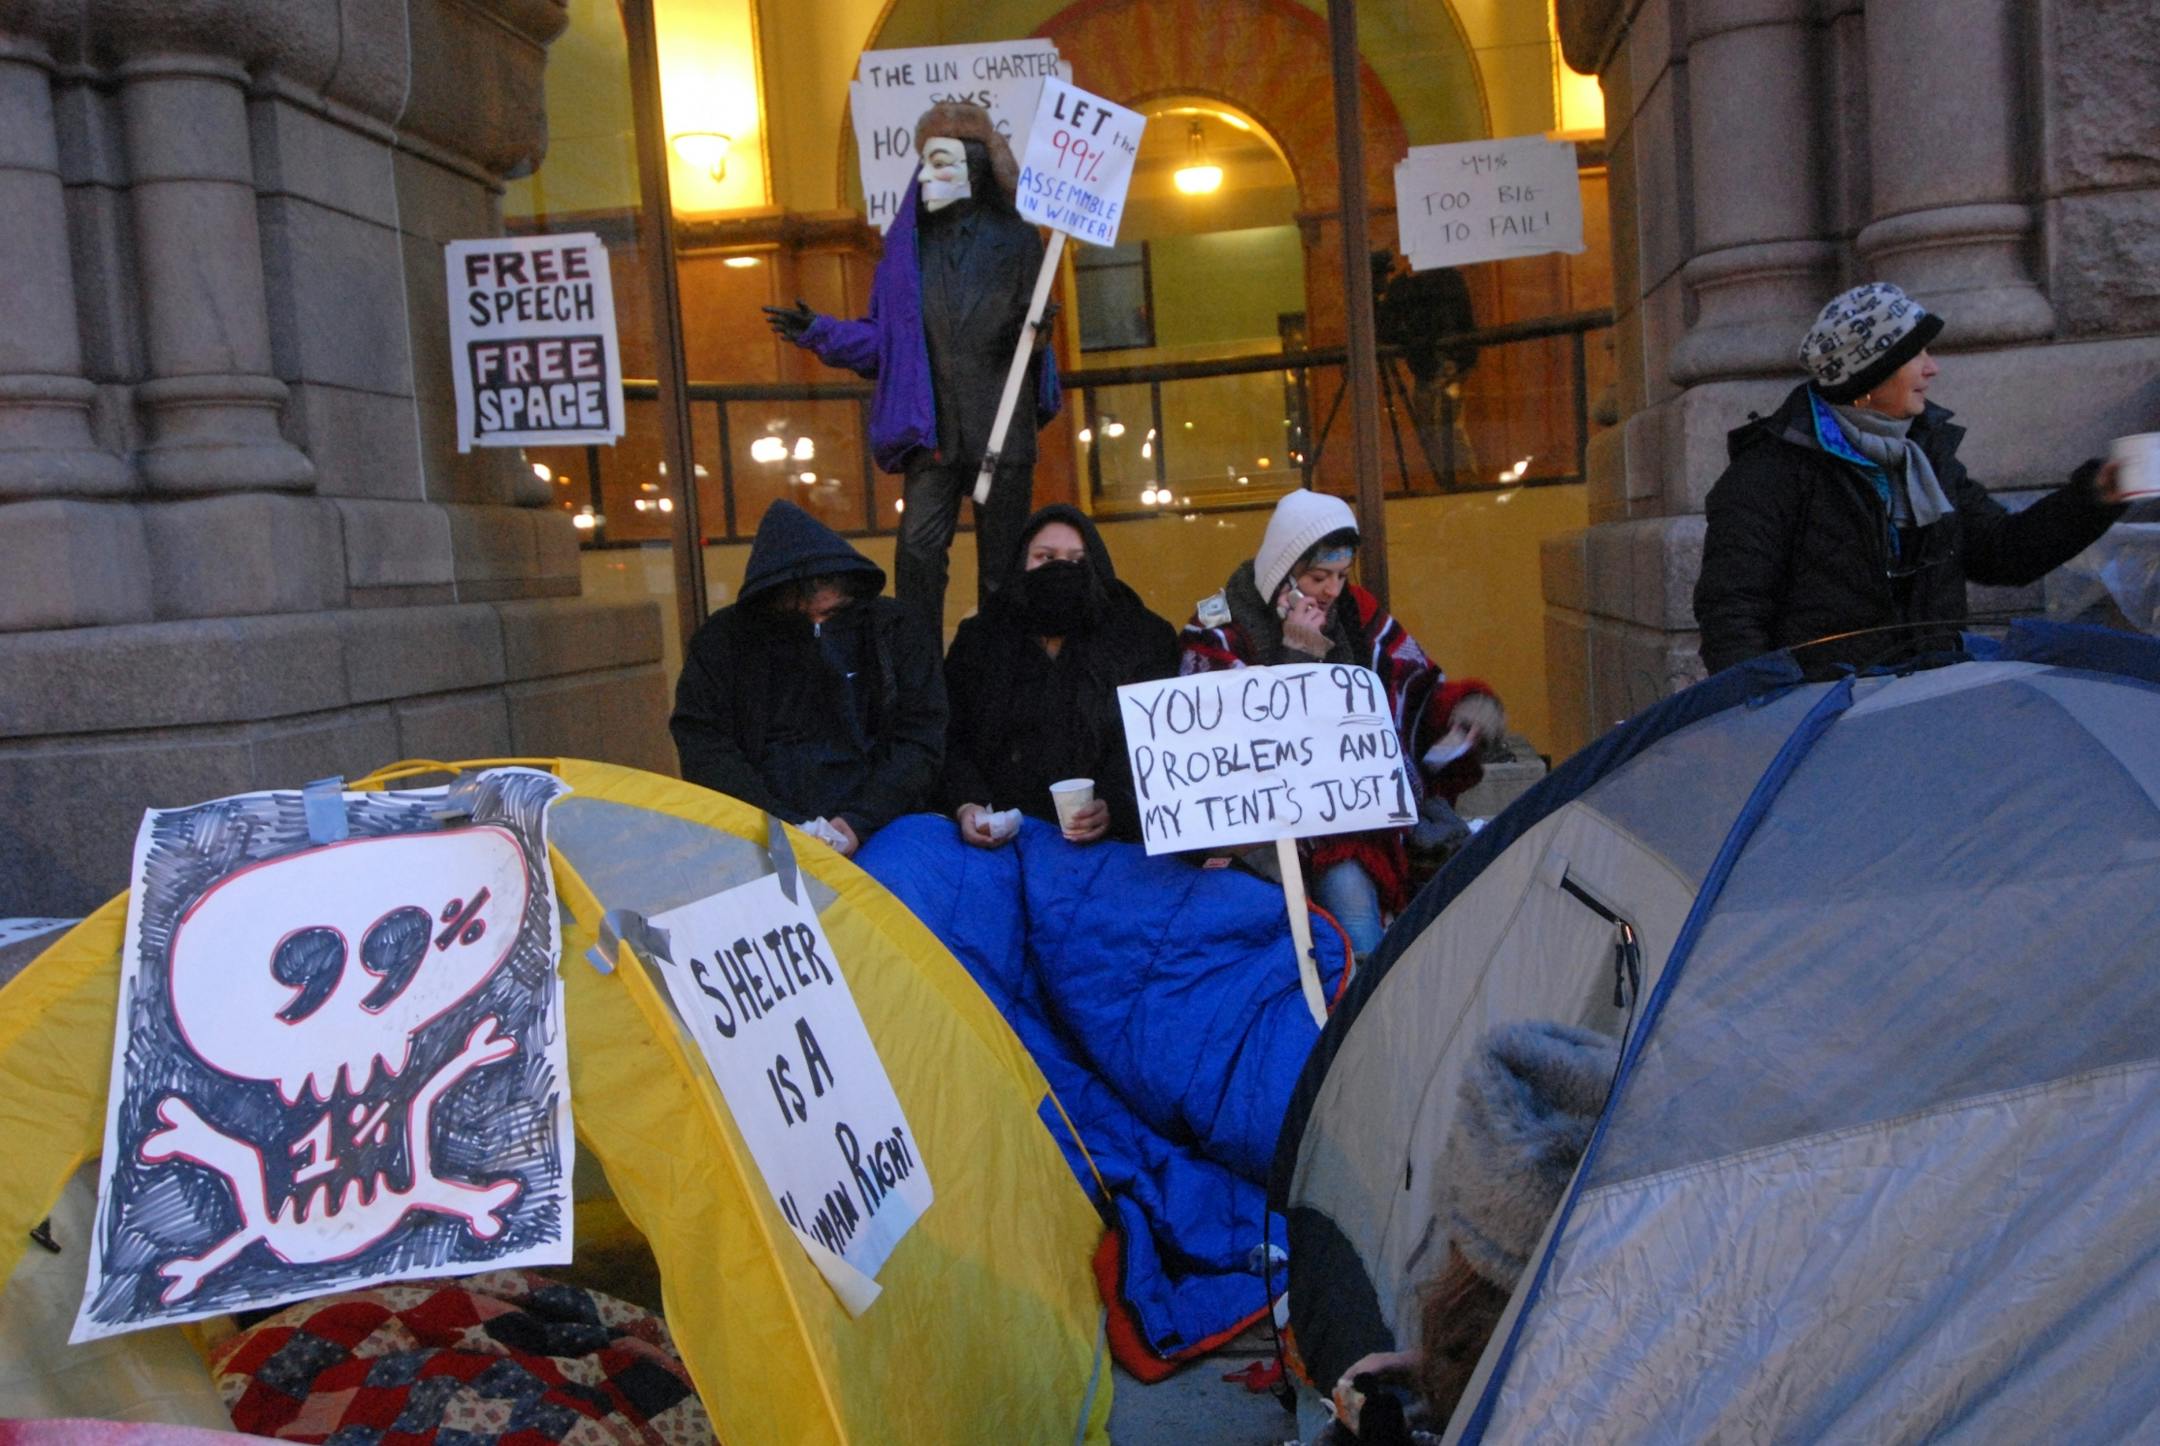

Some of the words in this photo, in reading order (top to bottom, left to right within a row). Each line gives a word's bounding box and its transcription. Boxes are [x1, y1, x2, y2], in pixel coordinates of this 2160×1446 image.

[870, 64, 914, 87] THE
[972, 52, 1059, 80] CHARTER
[1053, 92, 1112, 136] LET
[1112, 131, 1136, 155] the
[1052, 129, 1104, 182] 99%
[1024, 196, 1038, 211] IN
[1046, 204, 1114, 241] WINTER!
[1422, 191, 1470, 215] TOO
[1498, 185, 1544, 203] BIG
[1440, 220, 1470, 242] TO
[1489, 210, 1550, 236] FAIL!
[464, 247, 591, 288] FREE
[468, 283, 594, 327] SPEECH
[475, 341, 599, 384] FREE
[478, 381, 604, 431] SPACE
[1128, 684, 1223, 742] YOU
[1242, 670, 1318, 722] GOT
[1330, 665, 1377, 714] 99
[1135, 737, 1314, 800] PROBLEMS
[1339, 729, 1398, 762] AND
[1145, 799, 1181, 842] MY
[1195, 779, 1302, 831] TENT'S
[1310, 775, 1384, 823] JUST
[1388, 767, 1412, 819] 1
[270, 886, 492, 1026] 99%
[690, 923, 834, 1038] SHELTER
[767, 1054, 808, 1127] IS
[795, 1016, 834, 1098] A
[289, 1101, 390, 1184] 1%
[835, 1121, 914, 1218] RIGHT
